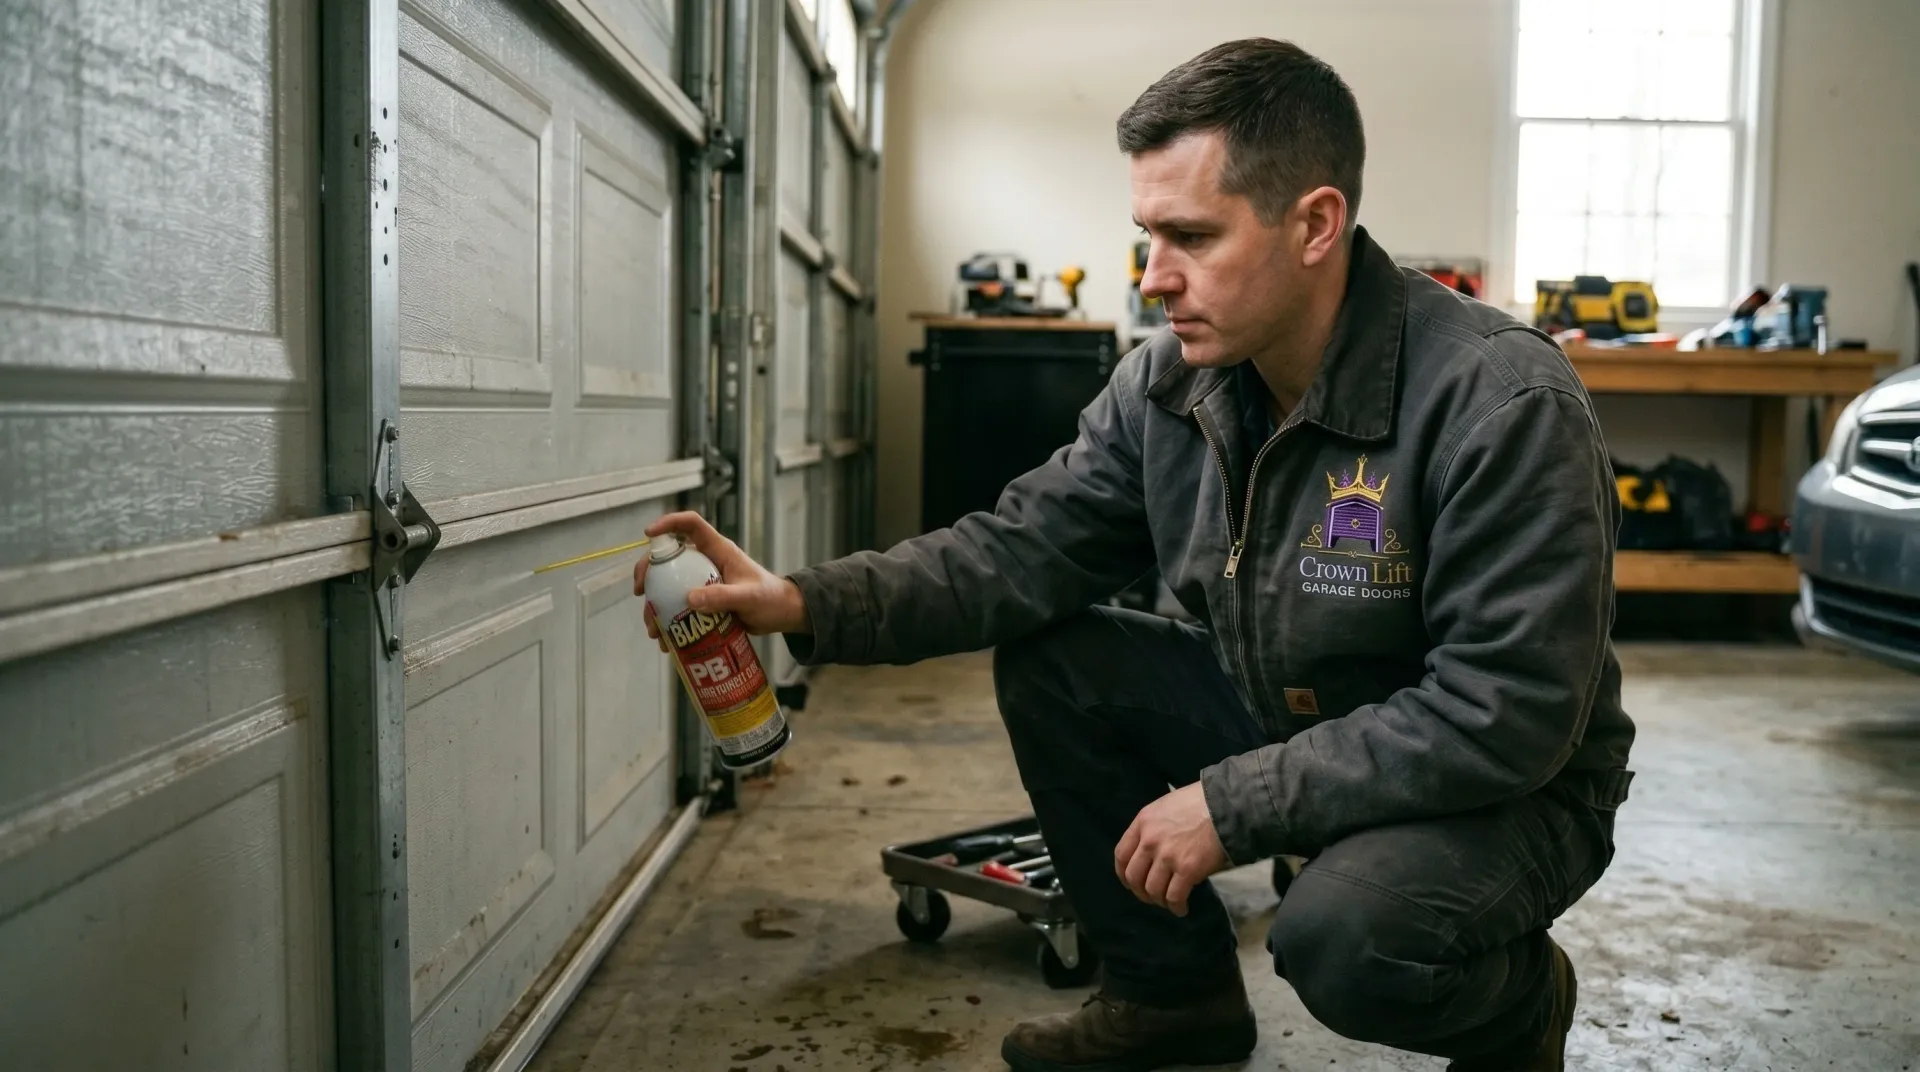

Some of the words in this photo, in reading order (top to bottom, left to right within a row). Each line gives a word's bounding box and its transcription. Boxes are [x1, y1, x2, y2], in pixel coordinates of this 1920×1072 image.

[1300, 556, 1368, 582] Crown
[1371, 562, 1412, 584] Lift
[1302, 581, 1356, 597] GARAGE
[1361, 587, 1411, 598] DOORS
[688, 656, 732, 686] PB
